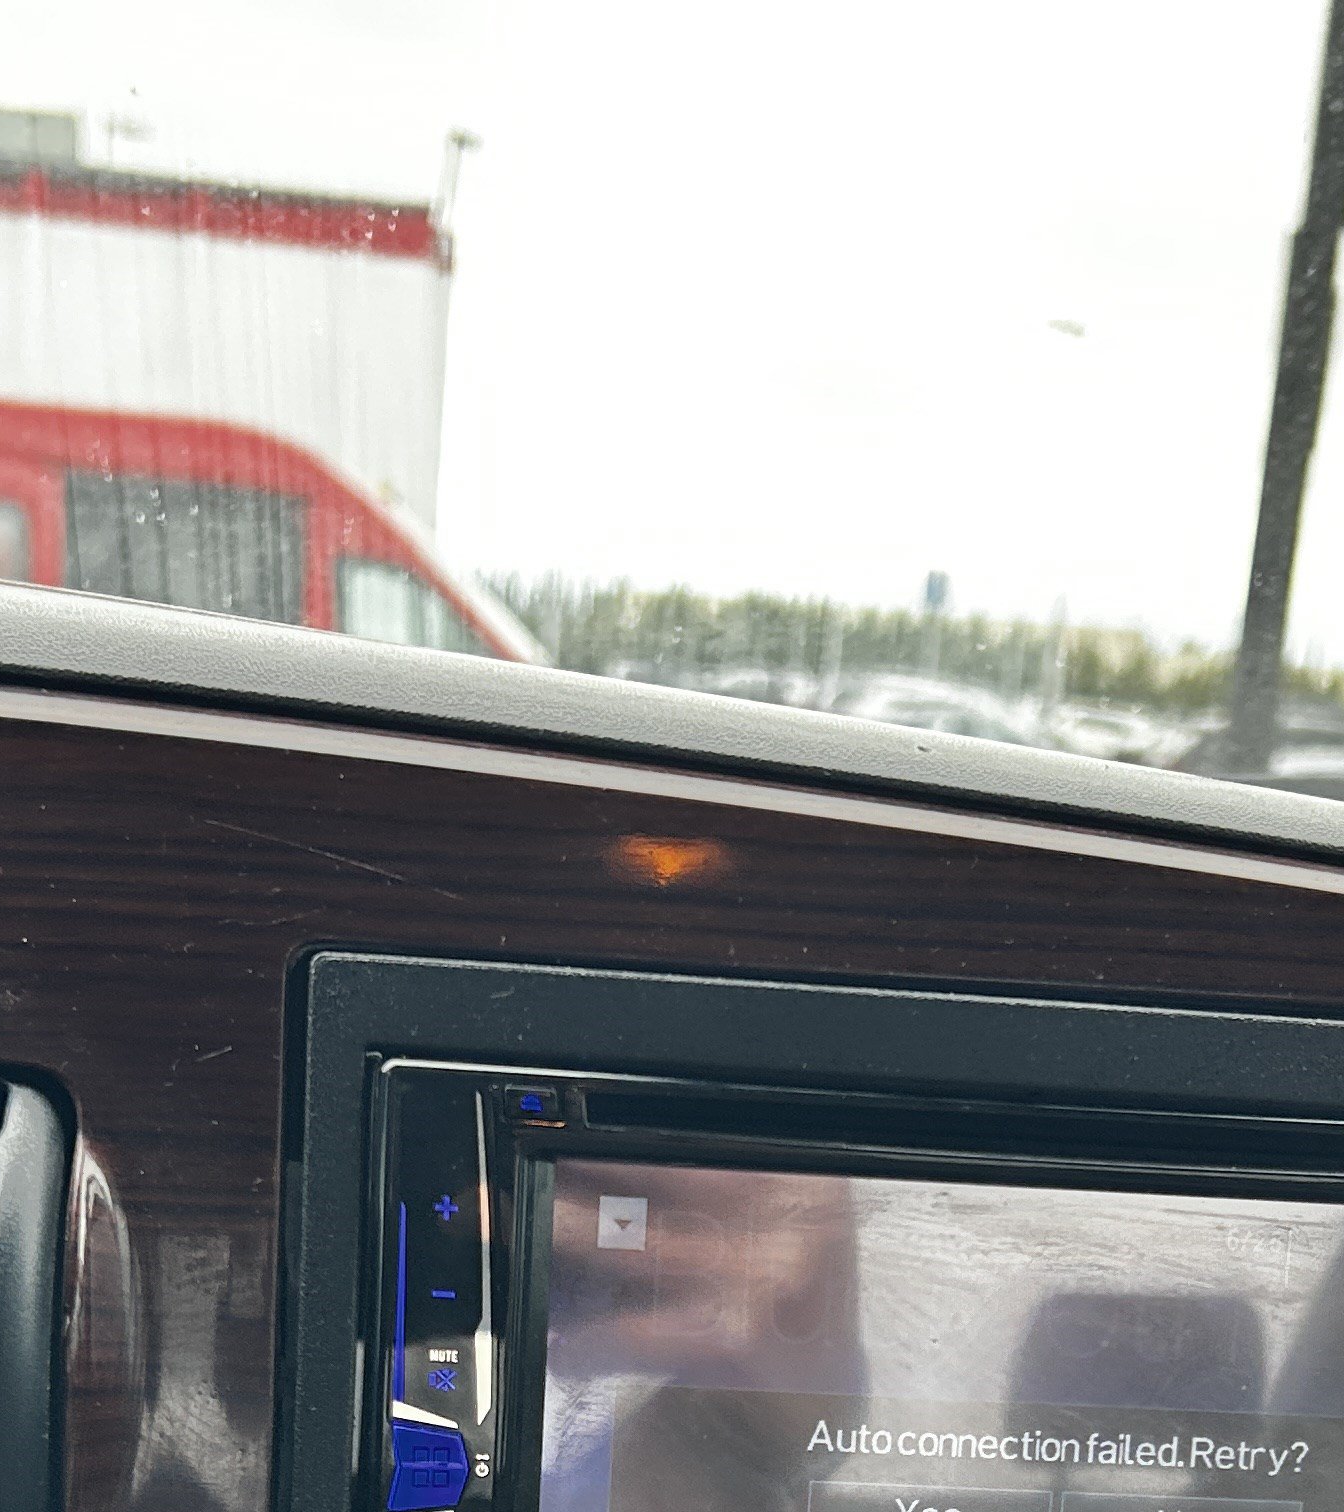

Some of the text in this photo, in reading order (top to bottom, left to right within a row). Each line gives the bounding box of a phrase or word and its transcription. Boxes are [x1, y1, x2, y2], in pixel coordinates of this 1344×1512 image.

[429, 1348, 459, 1363] MUTE
[807, 1419, 891, 1456] Auto
[896, 1423, 1080, 1464] connection
[1189, 1436, 1310, 1477] Retry?
